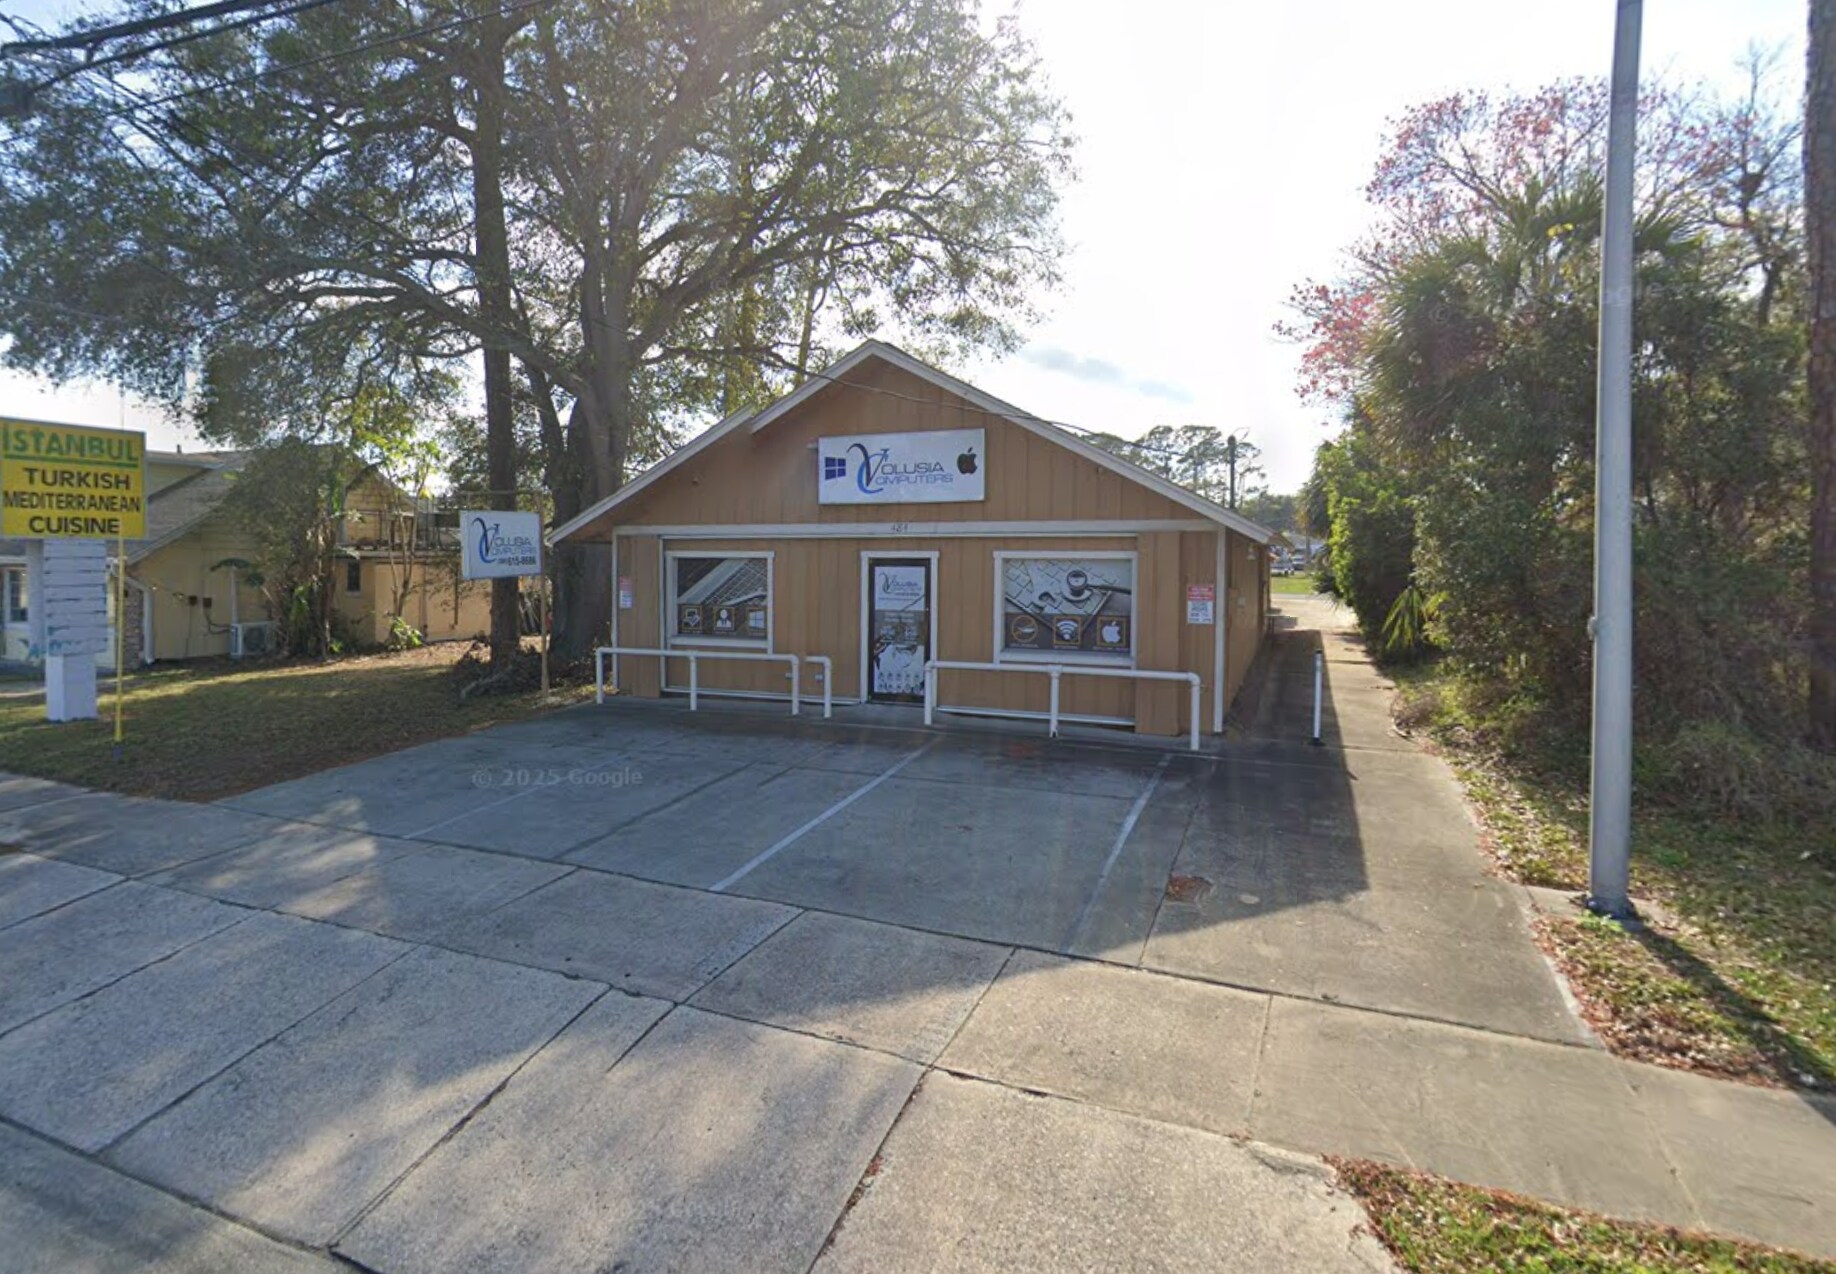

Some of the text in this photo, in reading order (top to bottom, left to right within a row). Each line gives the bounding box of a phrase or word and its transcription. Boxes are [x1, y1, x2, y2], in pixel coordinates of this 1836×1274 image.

[847, 443, 944, 487] VOLUSIA
[23, 467, 130, 490] TURKISH
[3, 491, 139, 512] MEDITERRANEAN
[28, 516, 119, 534] CUISINE
